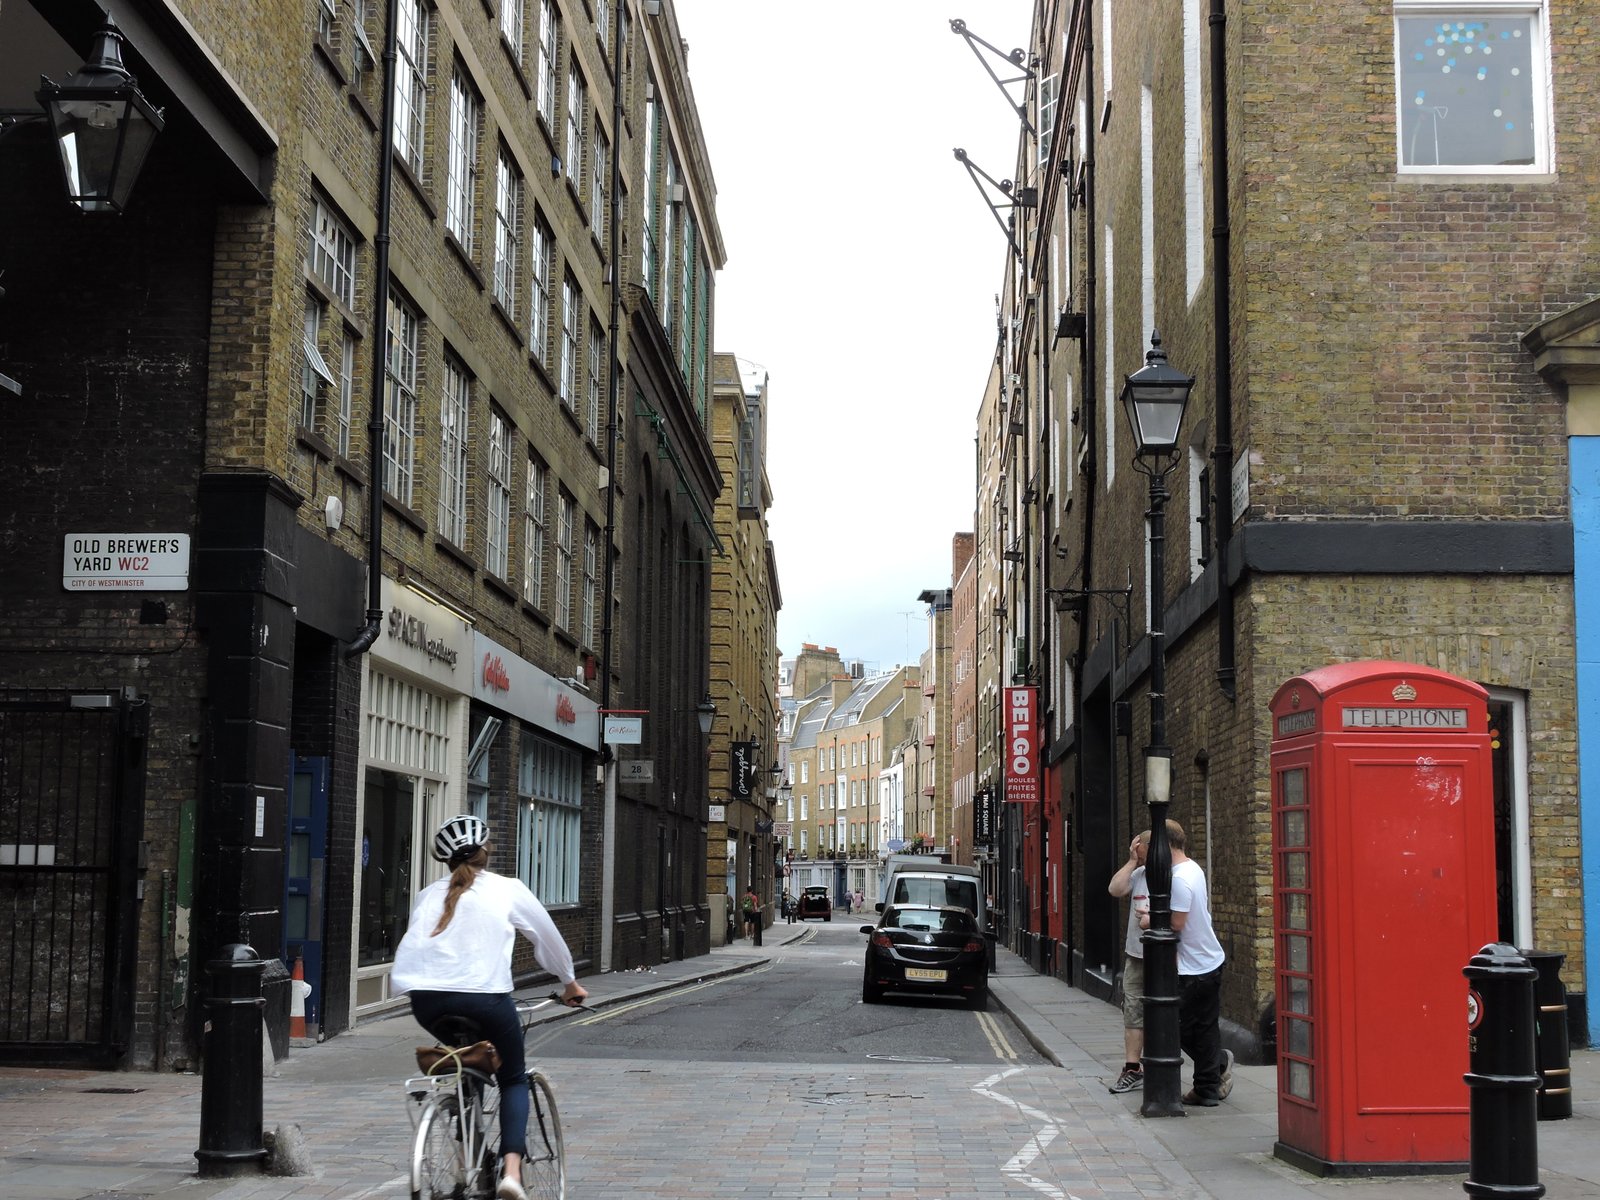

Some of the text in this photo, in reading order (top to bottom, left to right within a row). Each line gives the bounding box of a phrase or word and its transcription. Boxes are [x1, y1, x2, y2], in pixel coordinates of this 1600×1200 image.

[73, 539, 179, 554] OLD BREWER'S
[73, 556, 149, 571] YARD WC2
[97, 579, 144, 587] WESTMINSTER
[1279, 711, 1316, 733] TELEPHONE
[1347, 709, 1462, 726] TELEPHONE
[1012, 690, 1030, 775] BELGO
[631, 765, 642, 774] 28
[735, 747, 749, 795] pineapple
